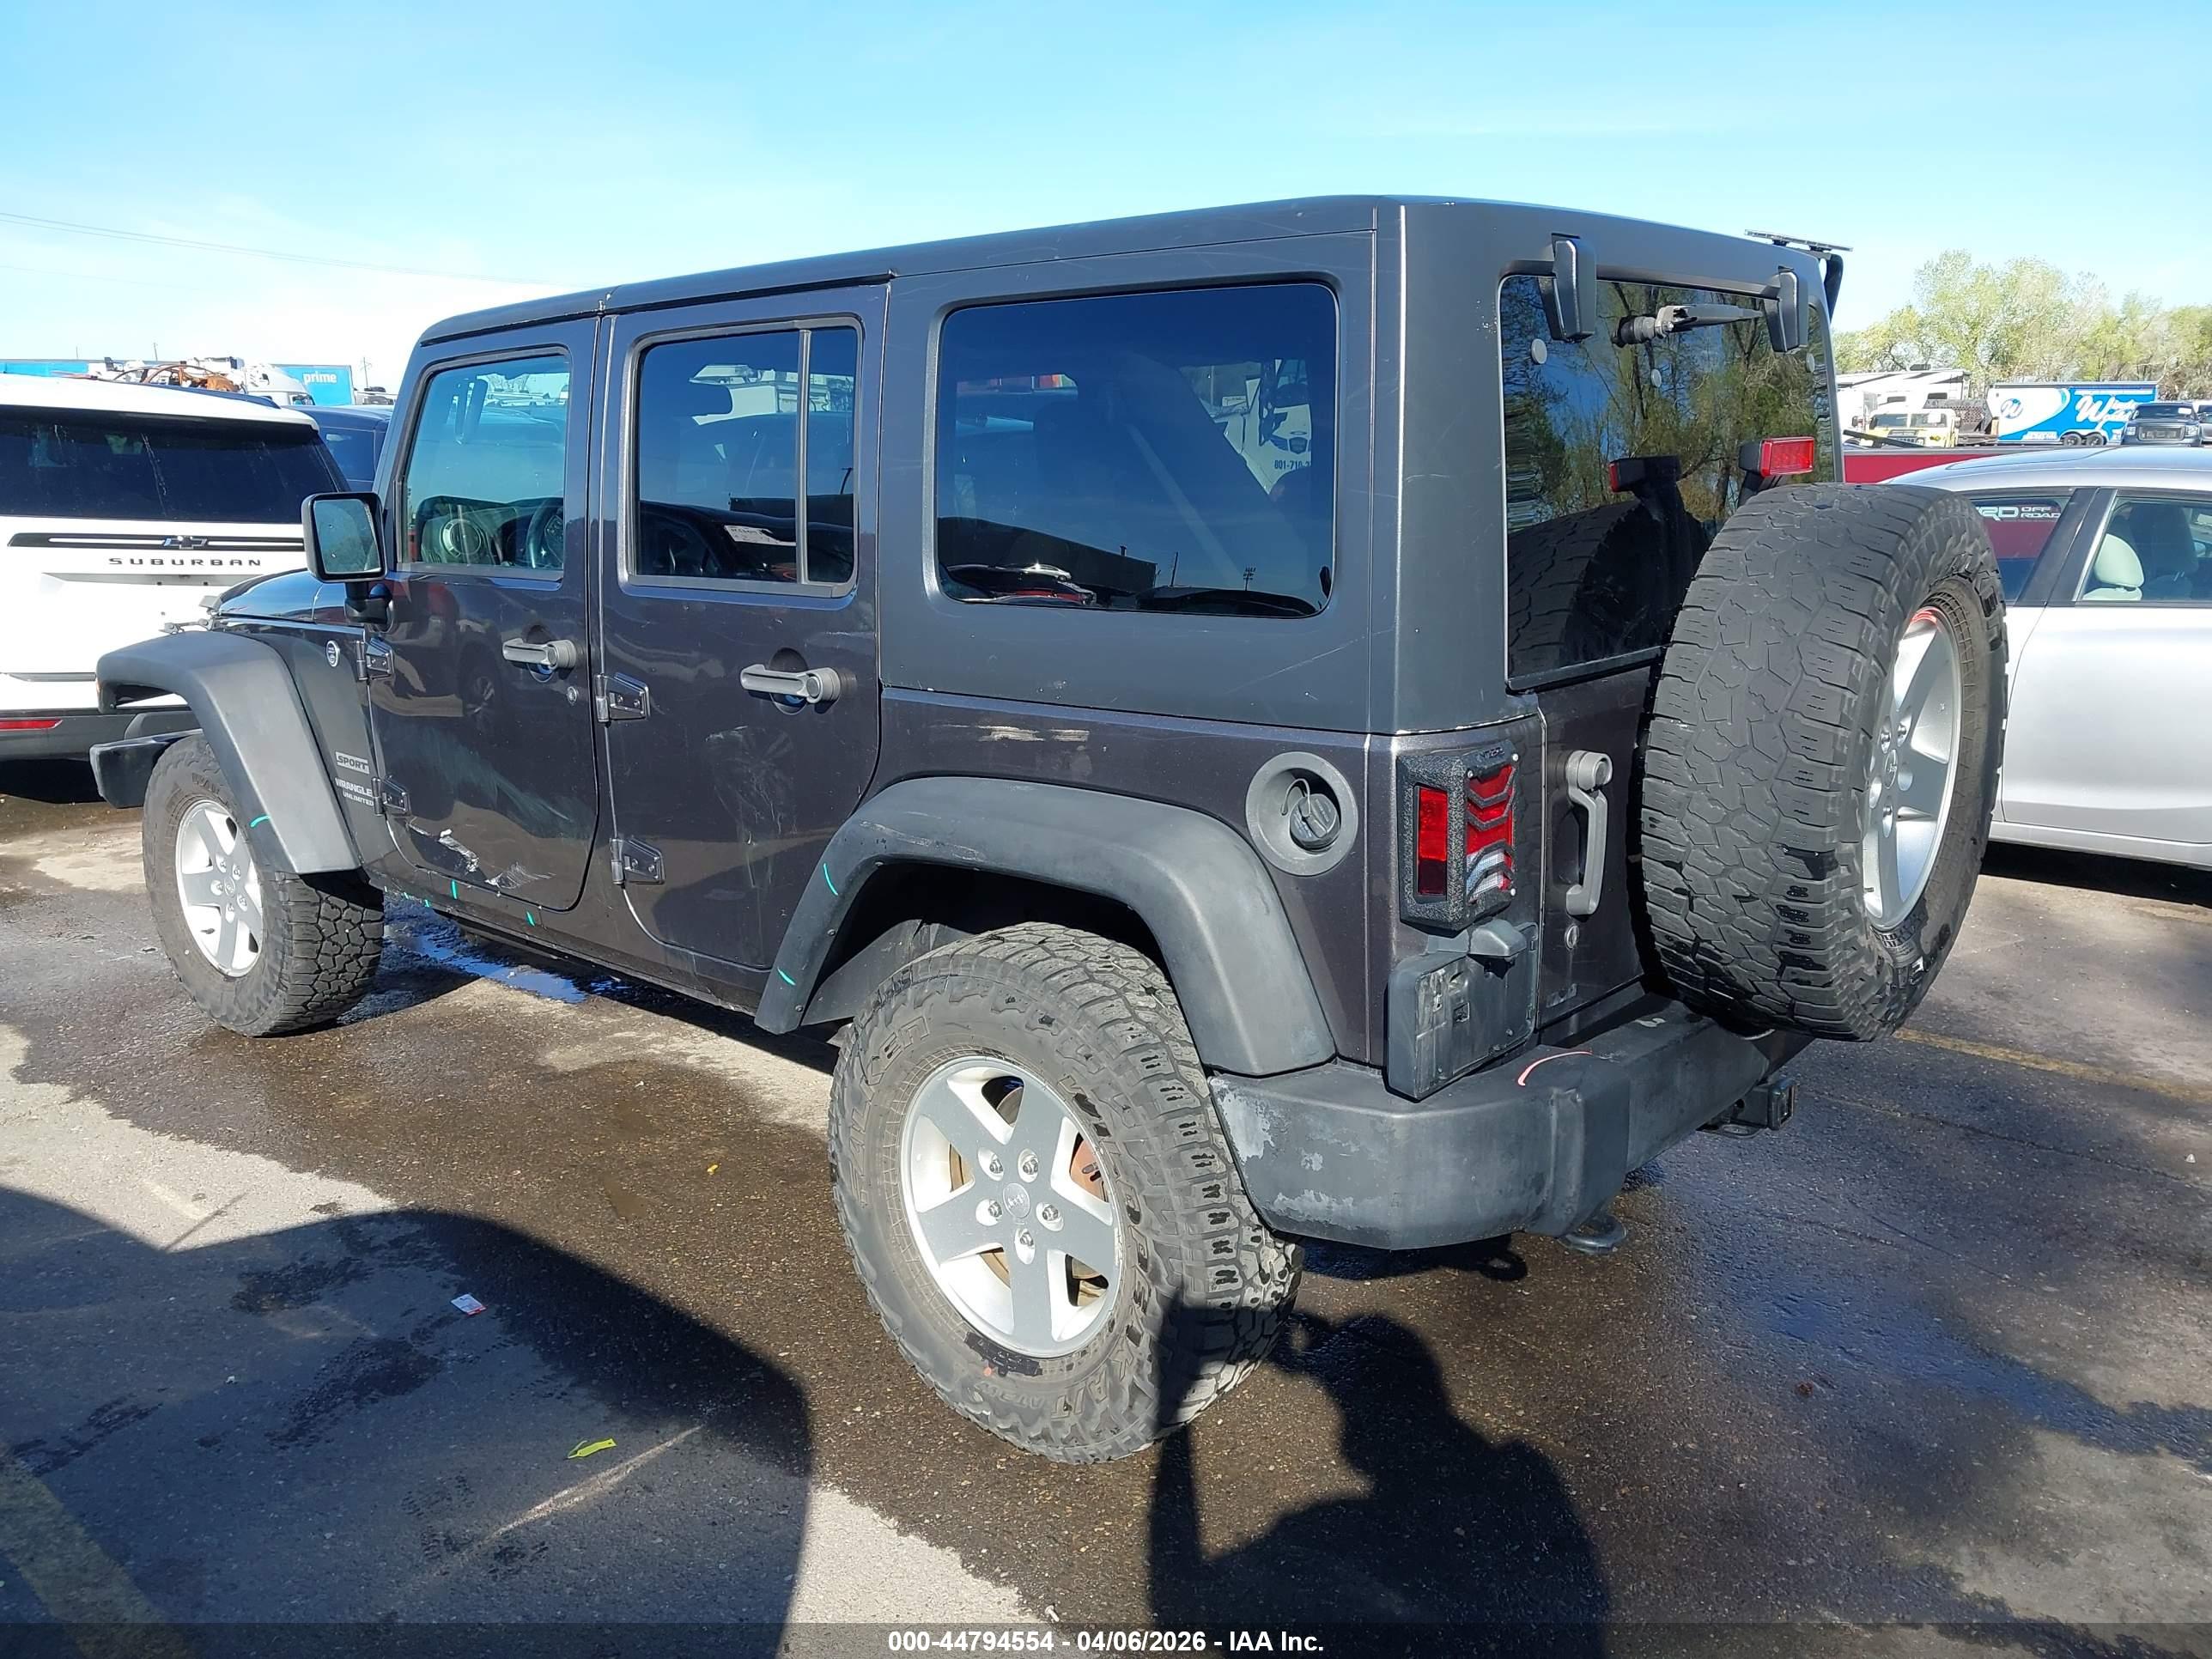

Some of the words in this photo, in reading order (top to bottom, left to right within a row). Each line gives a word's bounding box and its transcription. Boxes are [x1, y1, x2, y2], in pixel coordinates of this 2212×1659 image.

[303, 371, 337, 386] prime
[1976, 506, 2020, 521] RD
[108, 557, 261, 566] SUBURBAN
[337, 755, 368, 770] SPORT
[335, 777, 374, 798] WRANGLE
[343, 790, 374, 806] UNLIMITED
